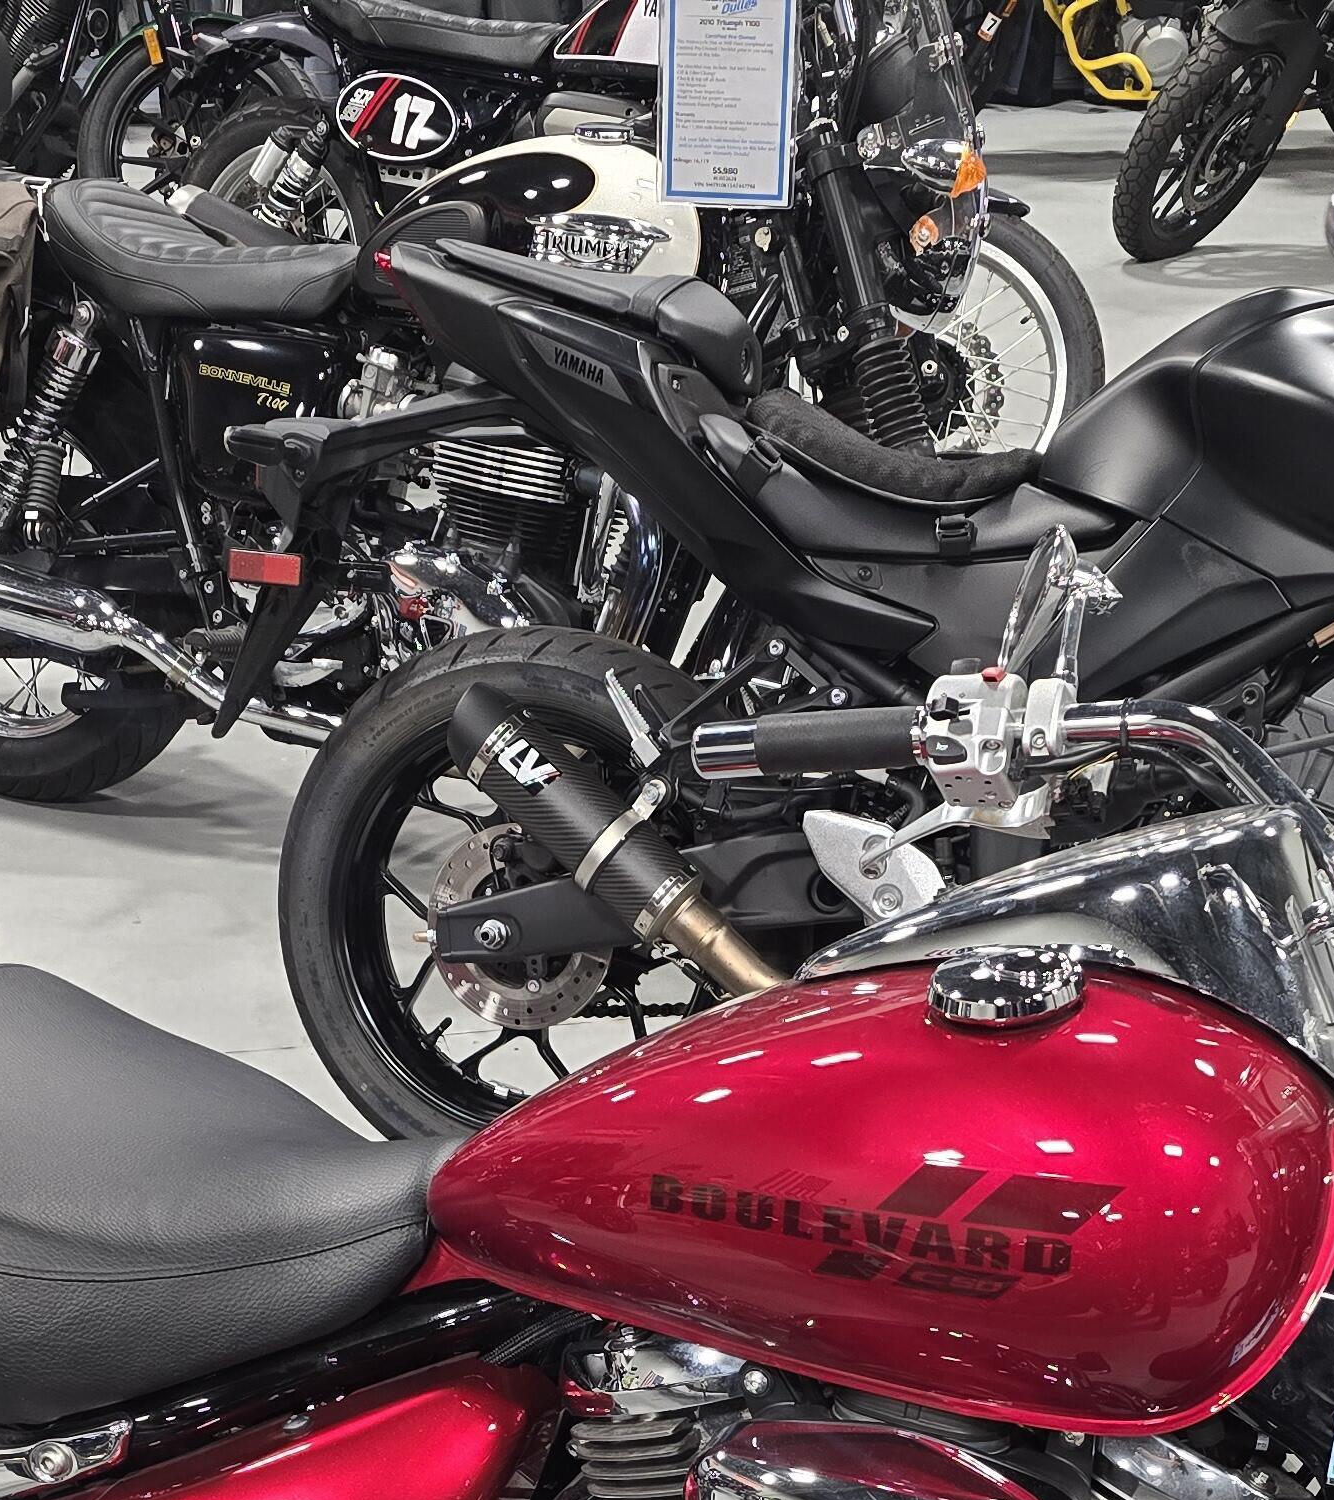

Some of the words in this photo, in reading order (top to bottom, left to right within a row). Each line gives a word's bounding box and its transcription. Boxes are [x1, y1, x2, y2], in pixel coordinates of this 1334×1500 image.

[716, 18, 743, 27] Triumph
[390, 92, 436, 150] 17
[539, 229, 632, 263] TRIUMPH
[198, 363, 291, 395] BONNEVILLE
[554, 346, 604, 386] YAMAHA
[256, 392, 290, 412] T100
[649, 1173, 1072, 1276] BOULEVARD
